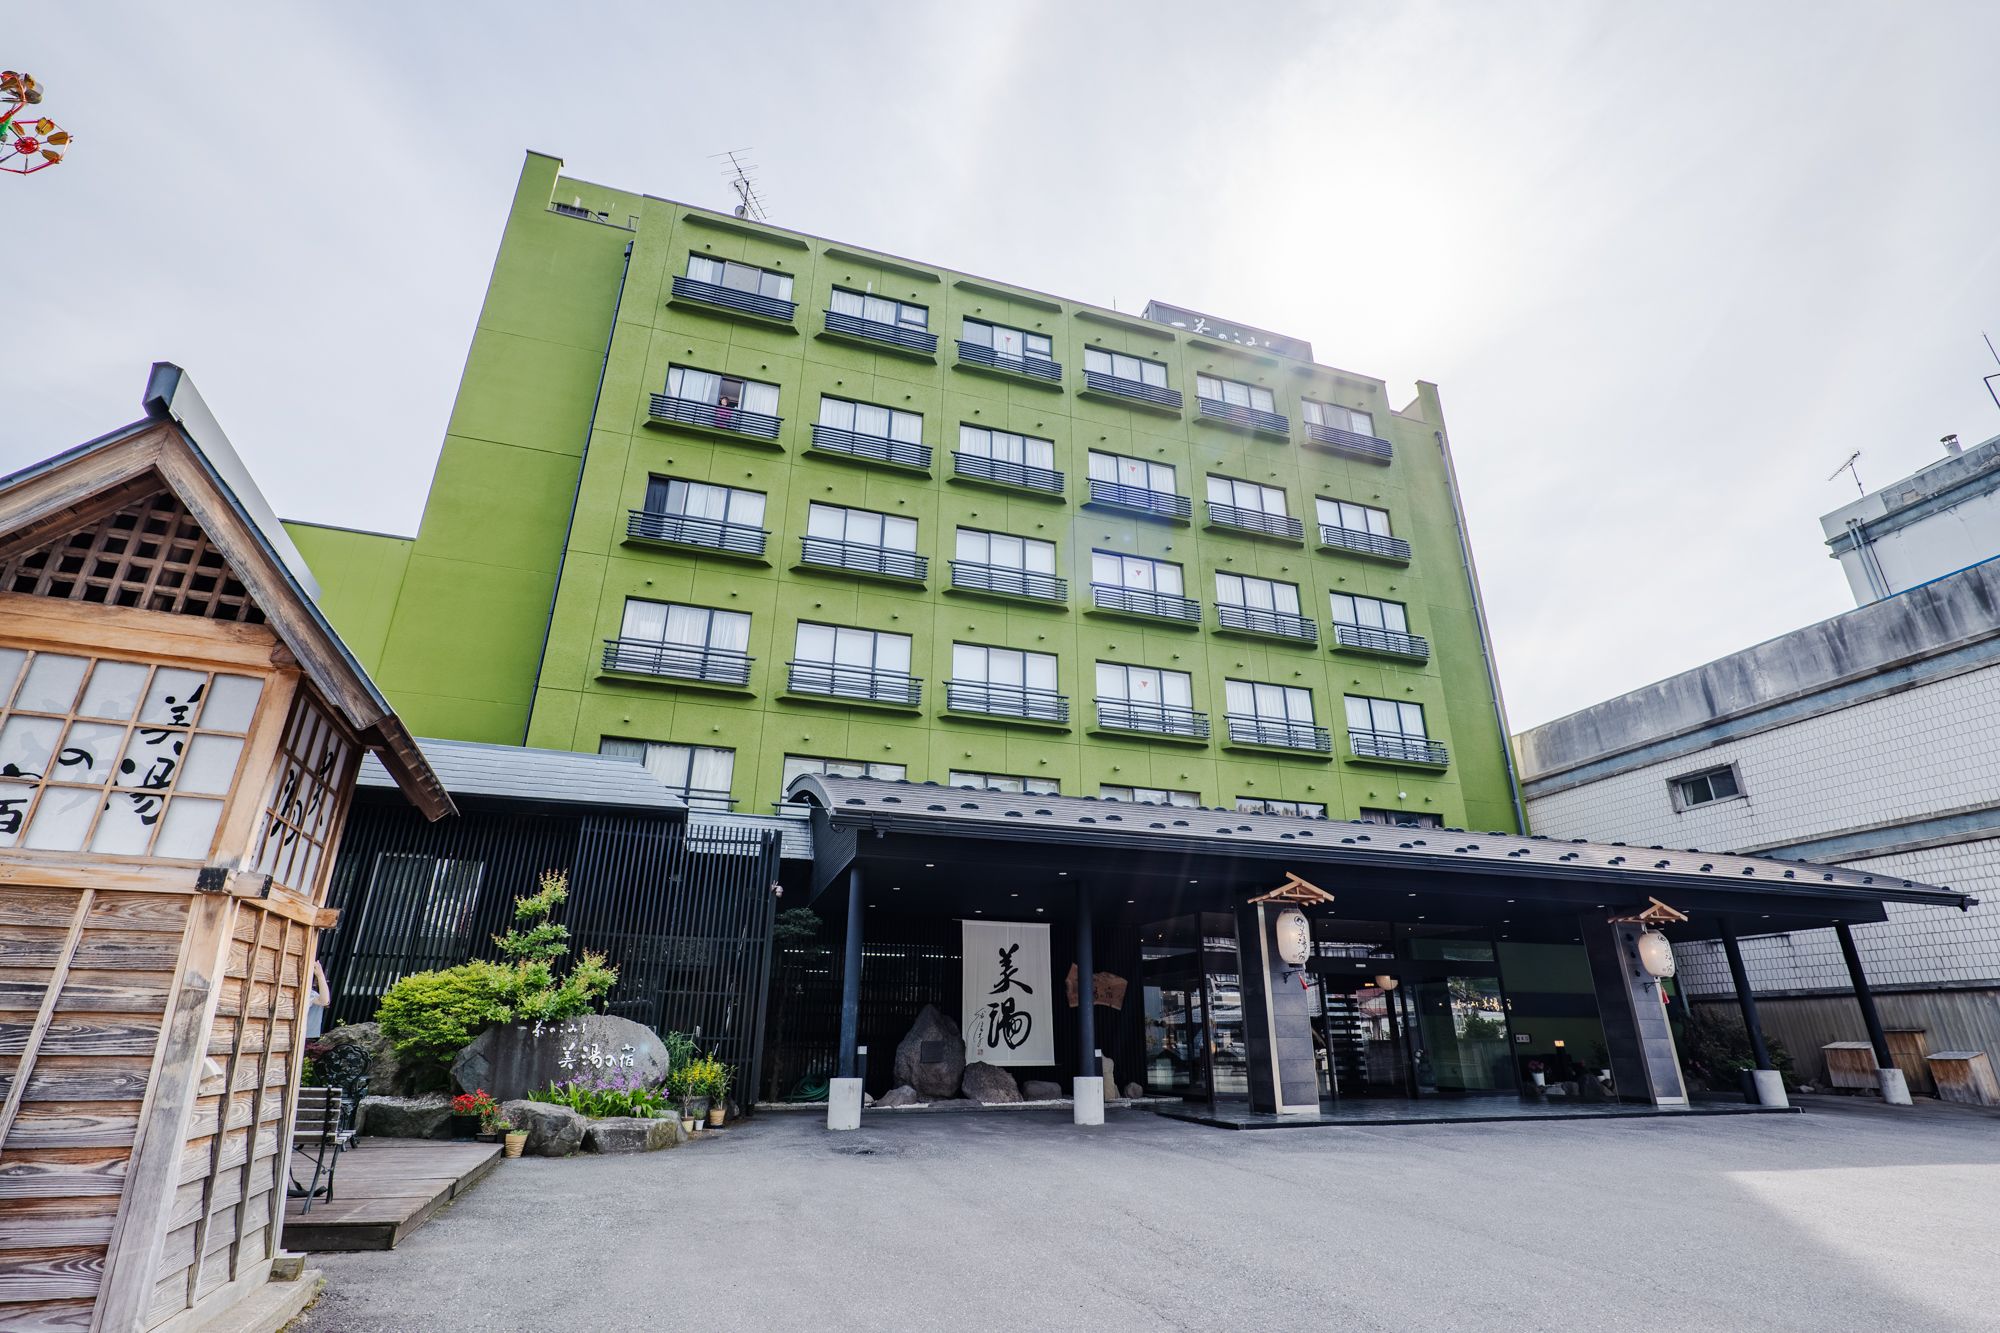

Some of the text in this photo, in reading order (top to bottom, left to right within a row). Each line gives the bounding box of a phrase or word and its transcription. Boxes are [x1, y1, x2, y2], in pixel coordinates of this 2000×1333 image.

[986, 943, 1033, 1050] 美湯
[558, 1042, 636, 1070] 美湯の宿
